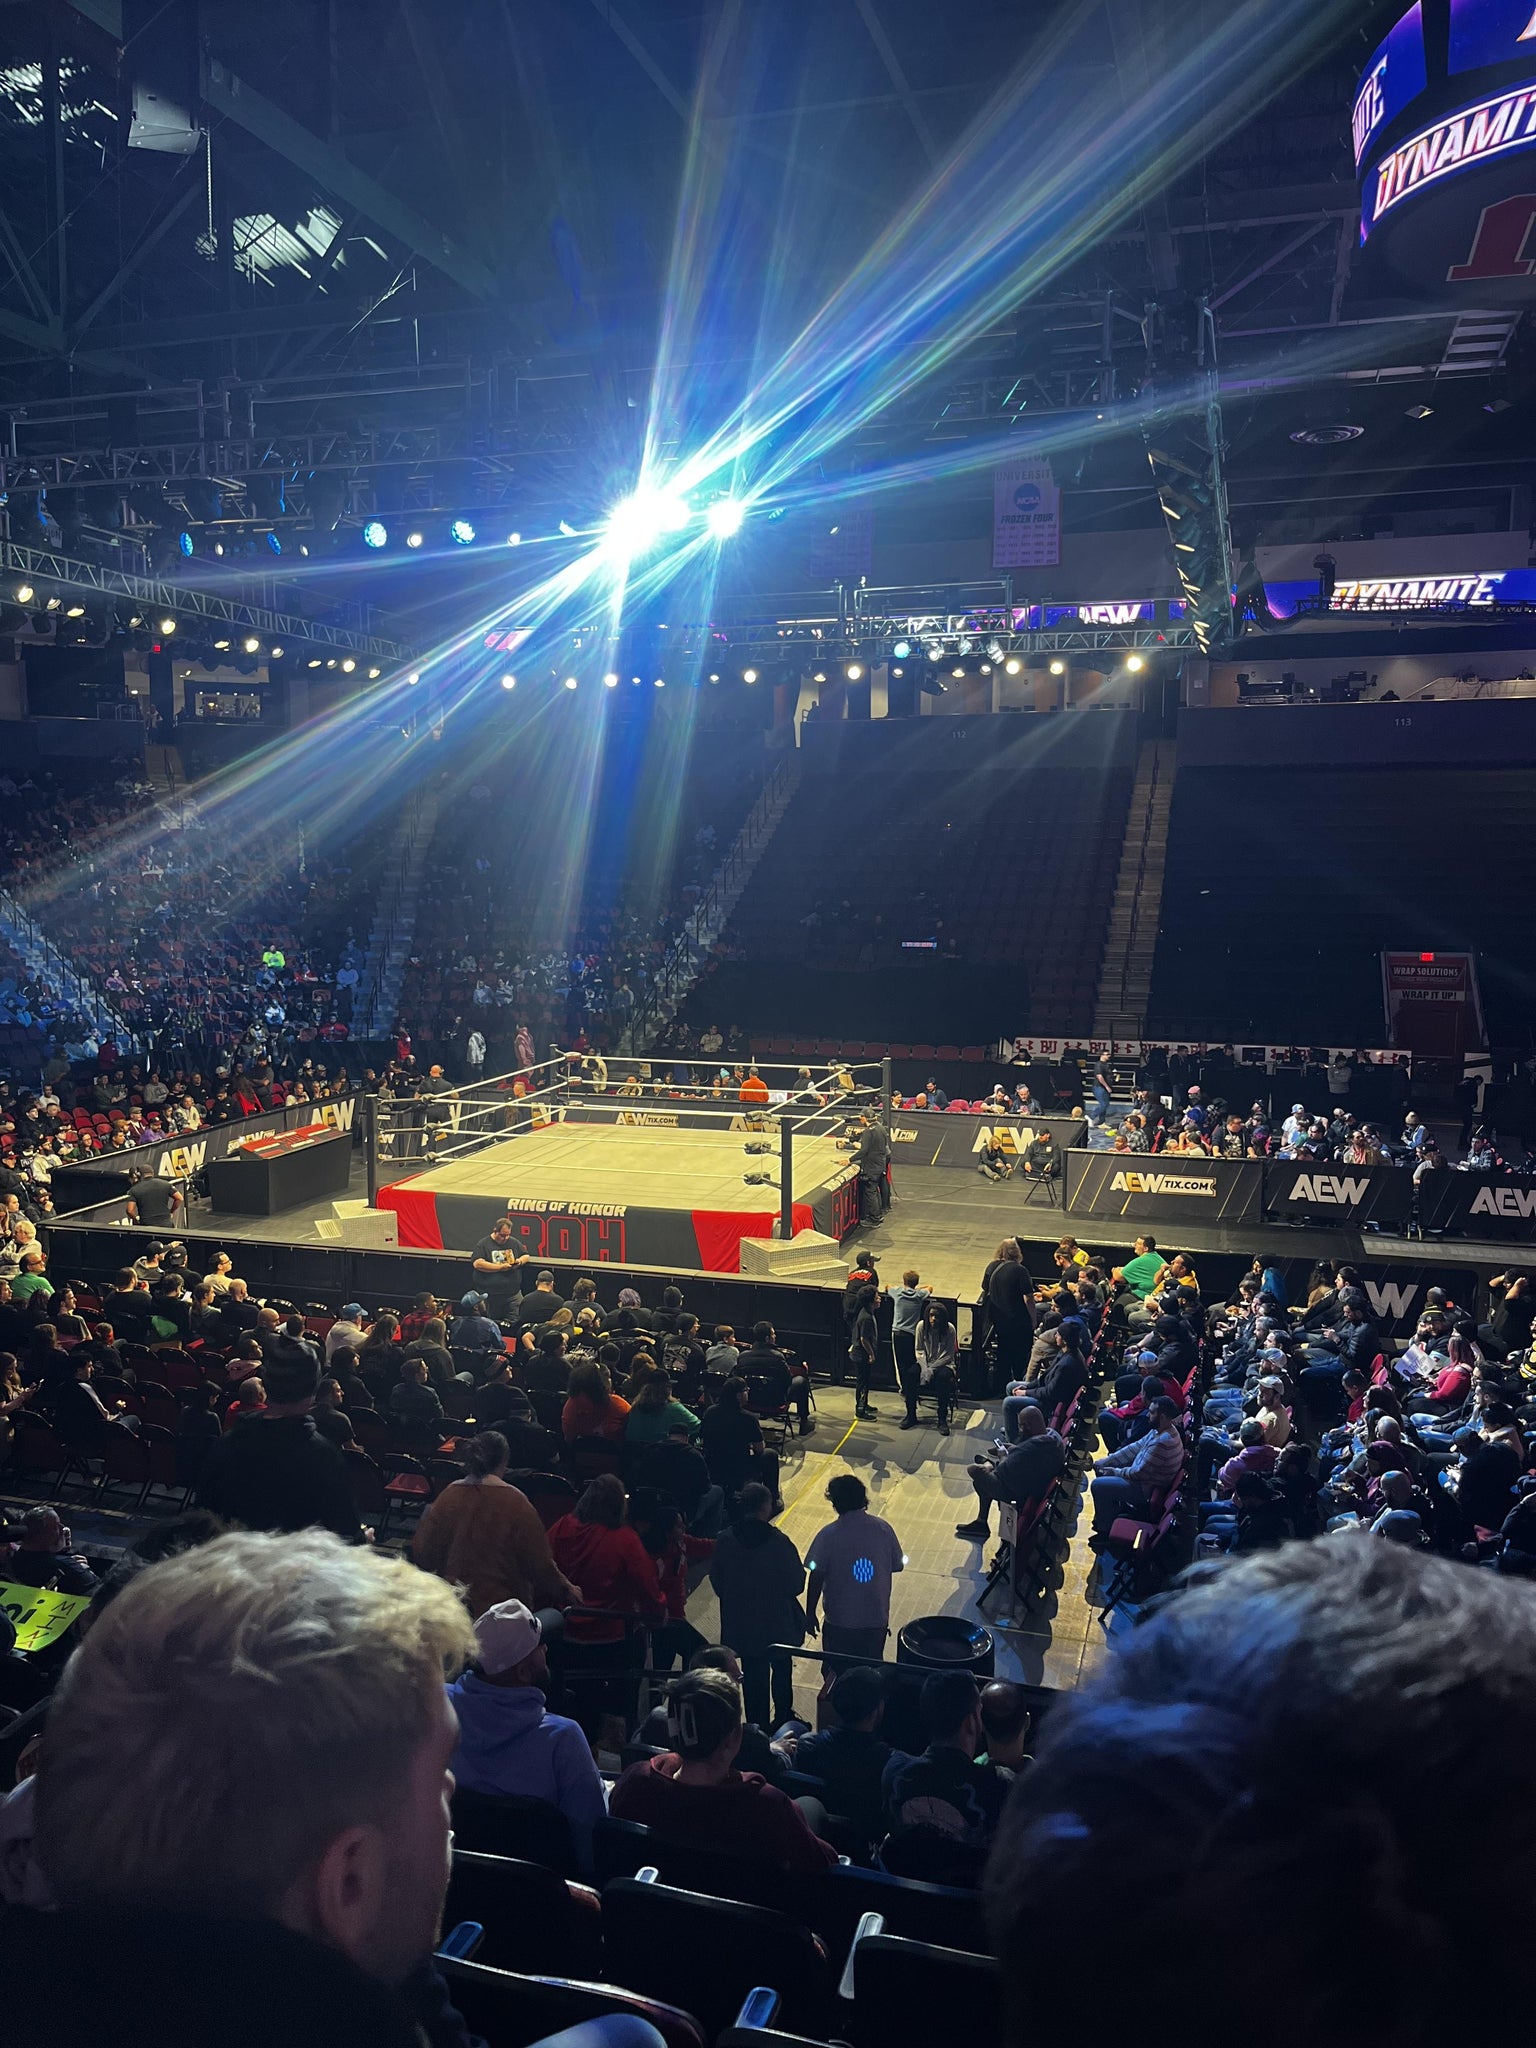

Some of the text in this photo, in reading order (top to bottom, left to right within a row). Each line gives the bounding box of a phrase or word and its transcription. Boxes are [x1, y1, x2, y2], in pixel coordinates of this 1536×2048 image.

[1372, 90, 1536, 222] DYNAMIT
[996, 468, 1051, 481] UNIVERSIT
[1001, 513, 1055, 524] FROZEN FOUR
[1329, 573, 1507, 610] DYNAMITE
[1394, 718, 1412, 727] 113
[952, 730, 967, 739] 112
[1393, 966, 1459, 977] WRAP SOLUTIONS
[1401, 990, 1457, 1000] WRAP IT UP!
[1040, 1040, 1057, 1054] BU
[158, 1141, 207, 1178] AEW
[1288, 1173, 1371, 1205] AEW
[507, 1199, 627, 1217] RING OF HONOR
